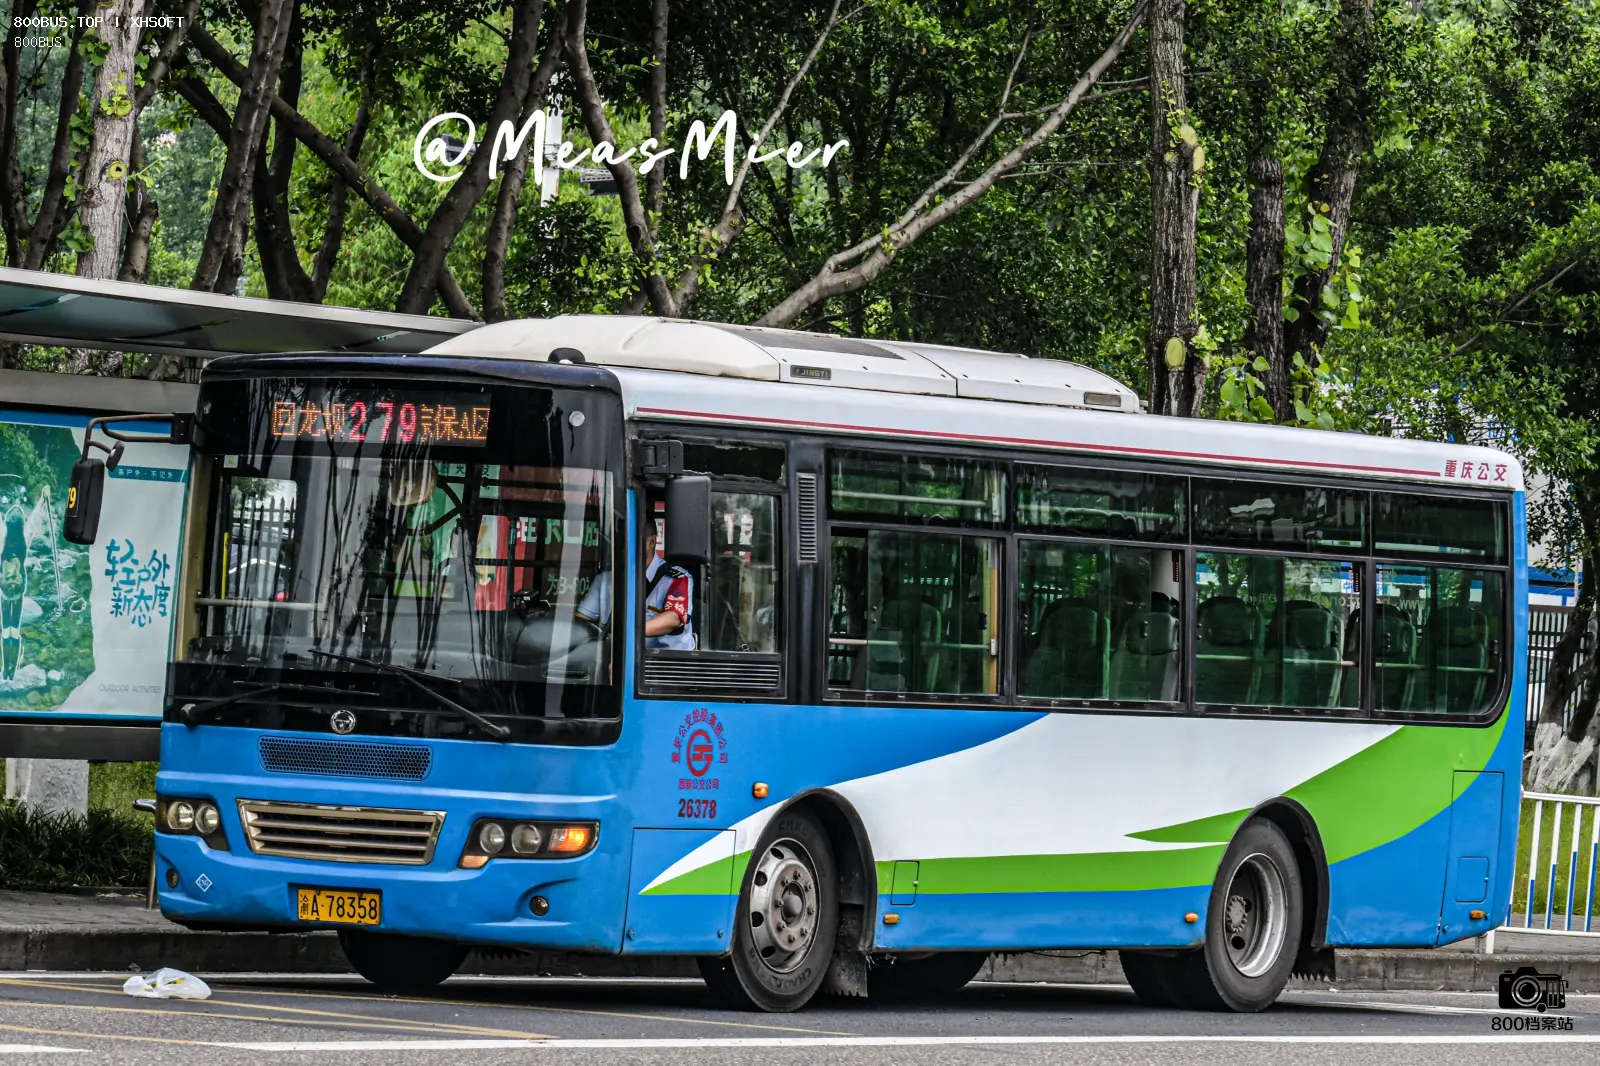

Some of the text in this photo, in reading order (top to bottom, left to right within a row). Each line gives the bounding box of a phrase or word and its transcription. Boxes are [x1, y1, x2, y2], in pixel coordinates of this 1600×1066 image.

[349, 401, 417, 442] 279
[1444, 459, 1508, 482] 重庆公交
[110, 581, 171, 628] 新态度
[677, 798, 718, 820] 26378
